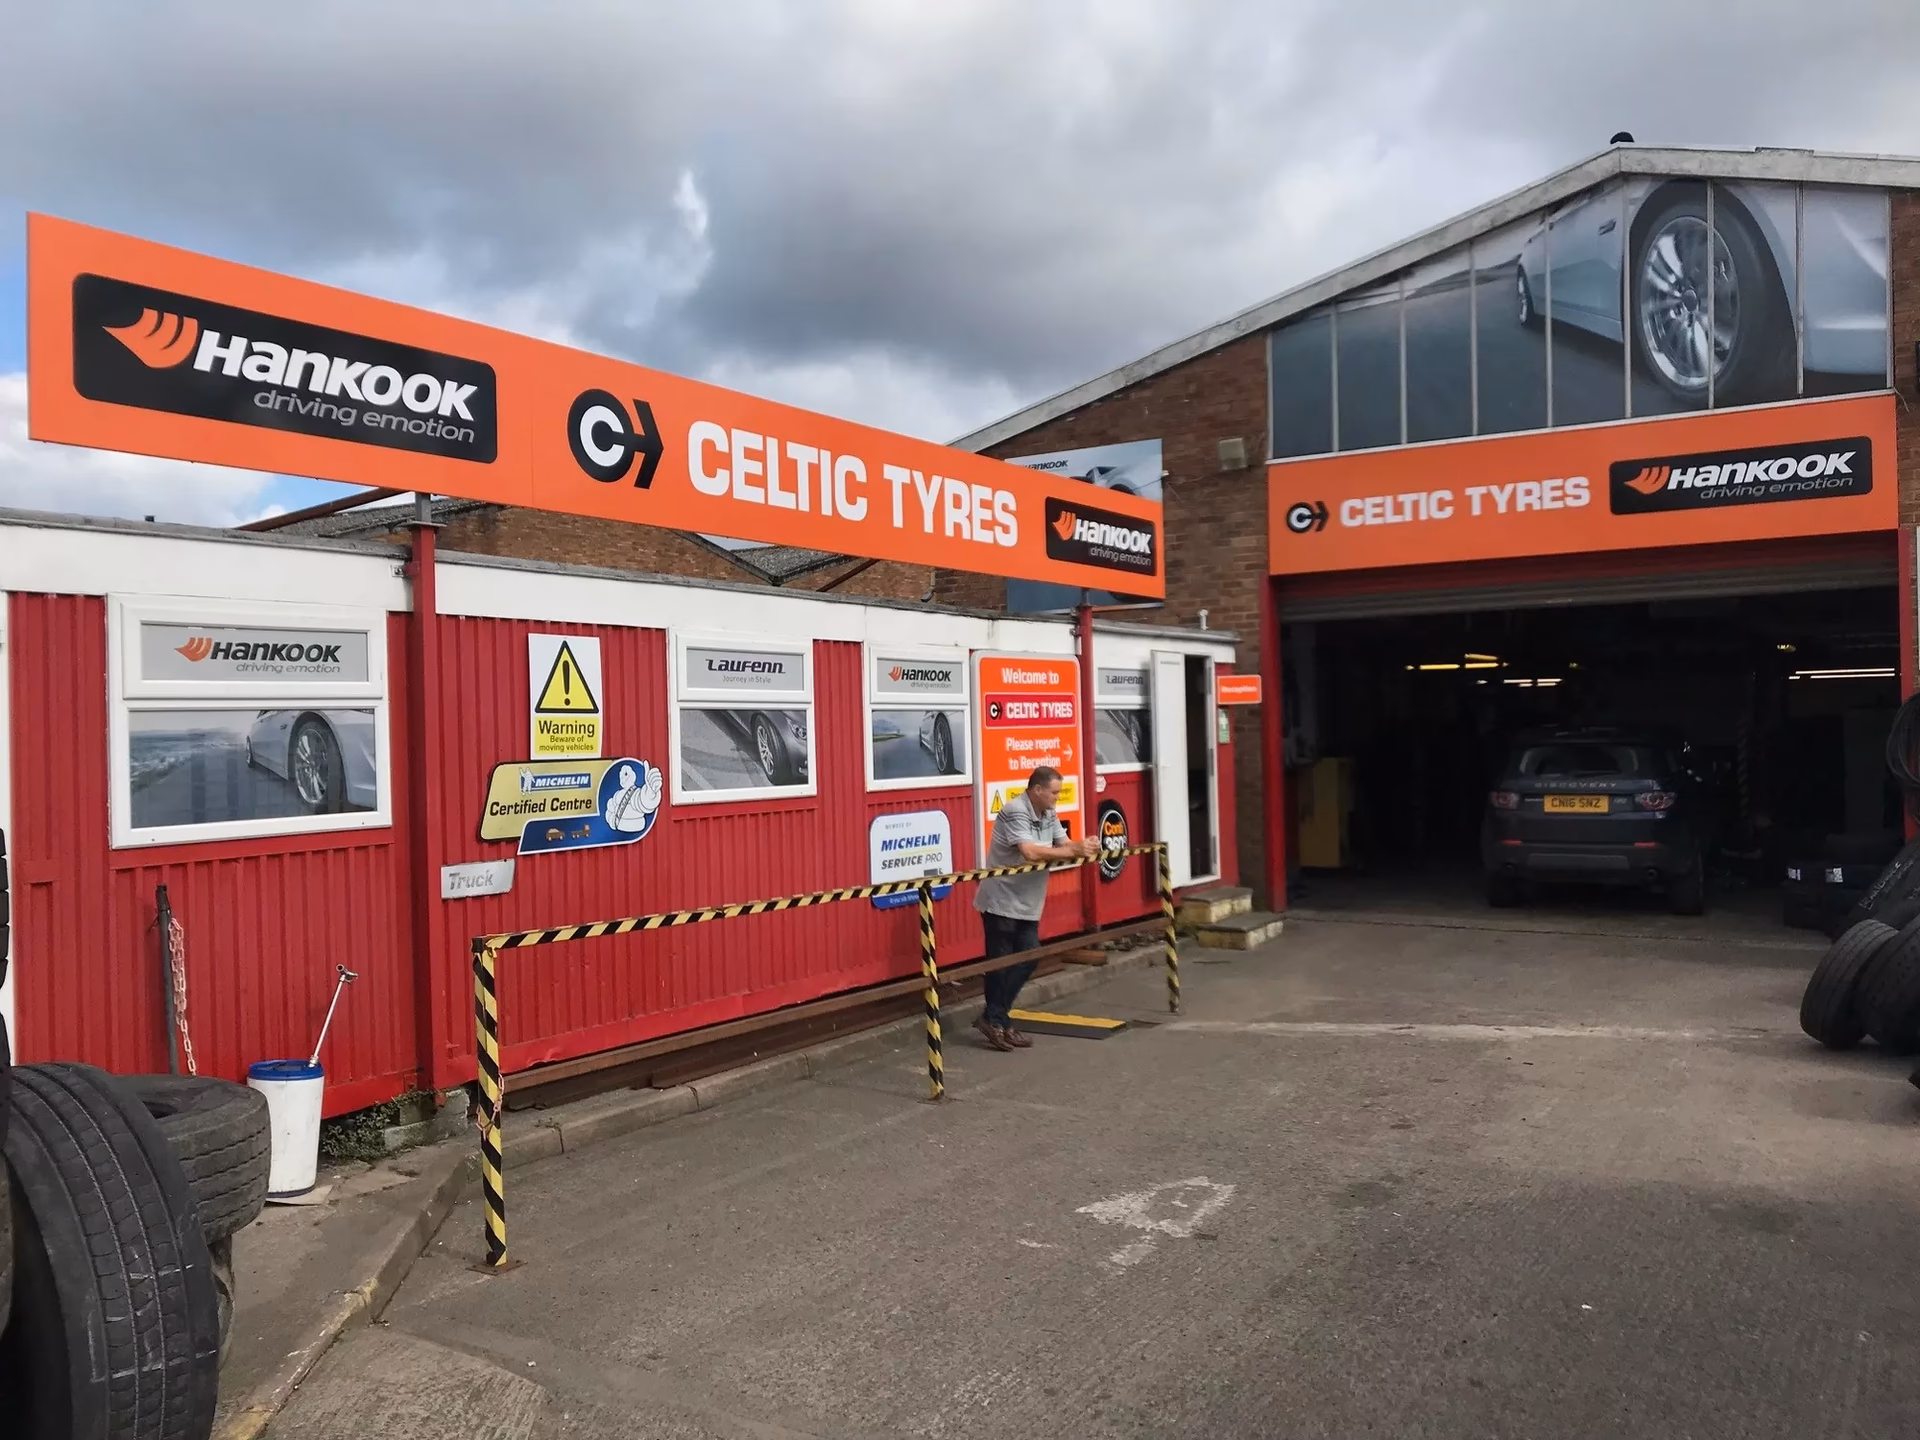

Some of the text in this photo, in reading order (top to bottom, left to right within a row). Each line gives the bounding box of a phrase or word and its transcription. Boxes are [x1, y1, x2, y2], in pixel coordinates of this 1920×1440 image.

[254, 388, 474, 443] driving emotion
[688, 420, 868, 522] CELTIC
[883, 464, 1018, 547] TYRES
[1700, 476, 1854, 499] driving emotion
[1340, 489, 1455, 527] CELTIC
[1465, 476, 1591, 516] TYRES
[1090, 546, 1151, 567] driving emotion
[236, 662, 340, 674] driving emotion
[1002, 667, 1059, 684] Welcome to
[722, 675, 747, 684] Journey
[755, 675, 772, 684] Style
[910, 681, 929, 689] driving
[1006, 702, 1039, 718] CELTIC
[1041, 701, 1073, 718] TYRES
[538, 719, 595, 737] Warning
[550, 734, 584, 743] Beware of
[1006, 737, 1060, 752] Please report
[539, 743, 594, 752] moving vehicles
[1008, 757, 1019, 771] to
[535, 775, 589, 787] MICHELIN
[489, 797, 592, 816] Certified Centre
[1551, 797, 1575, 808] CN16
[1579, 798, 1601, 808] SNZ
[881, 833, 941, 852] MICHELIN
[881, 852, 943, 870] SERVICE PRO
[449, 870, 494, 891] Truck
